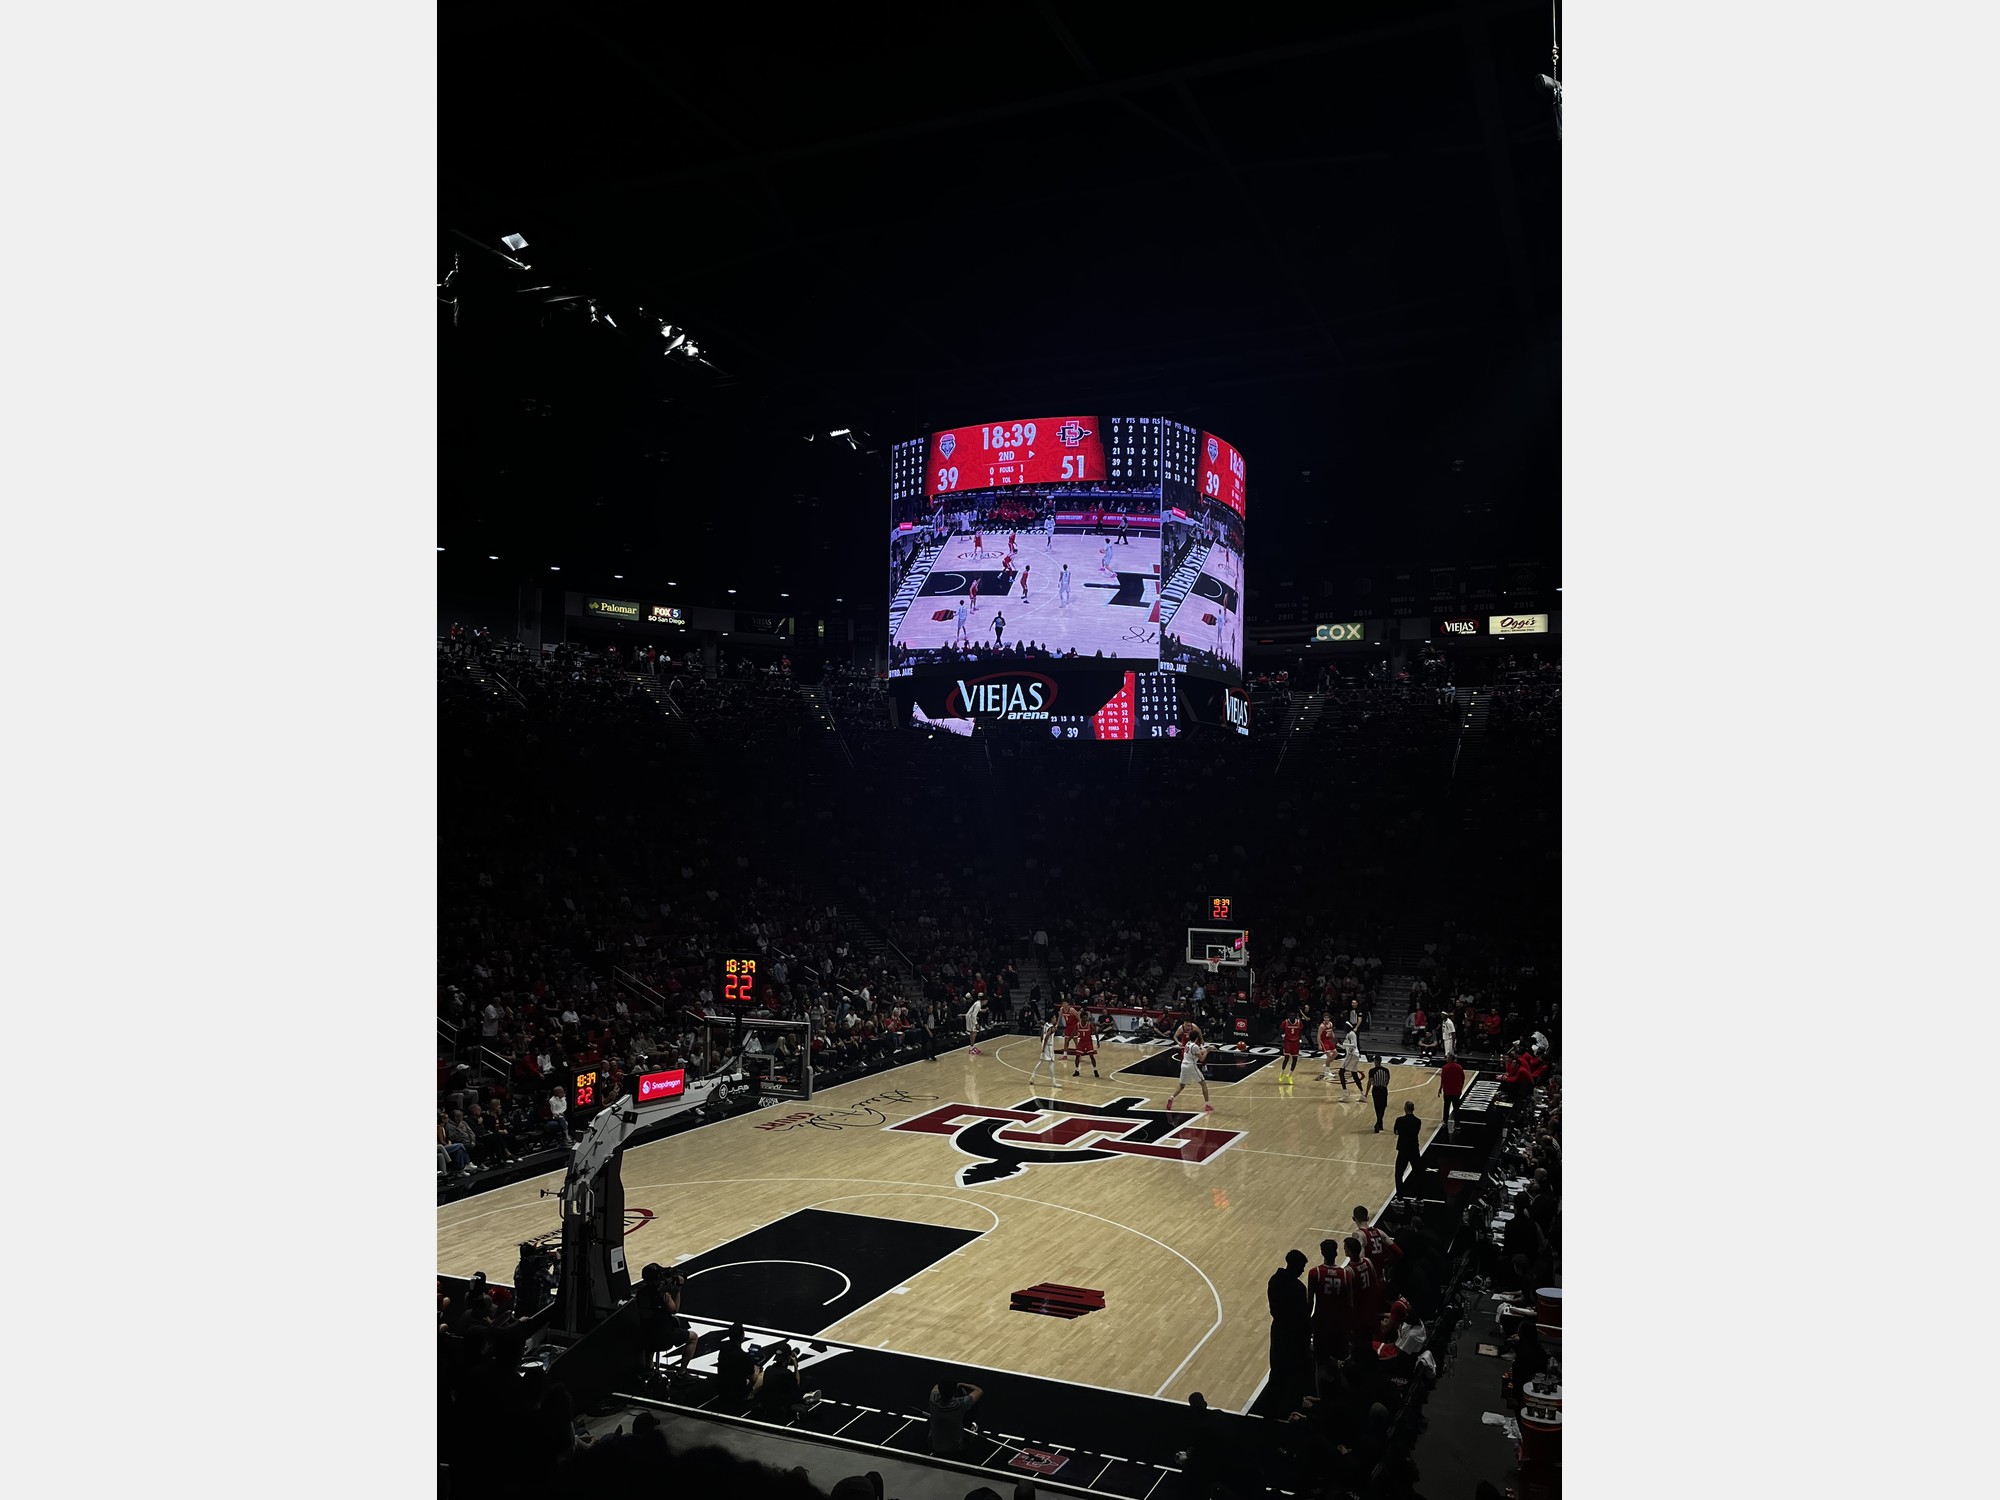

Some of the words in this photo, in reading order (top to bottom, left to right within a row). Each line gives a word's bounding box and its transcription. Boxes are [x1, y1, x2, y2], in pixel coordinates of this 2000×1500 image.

[982, 422, 1036, 450] 18:39
[998, 451, 1014, 462] 2ND
[990, 467, 994, 475] 0
[1060, 455, 1085, 479] 51
[938, 466, 958, 490] 39
[990, 478, 994, 486] 3
[1019, 475, 1024, 483] 3
[1206, 471, 1219, 496] 39
[601, 602, 637, 614] Palomar
[654, 607, 672, 617] FOX
[673, 609, 678, 618] 5
[1444, 622, 1474, 634] VIEJAS
[1500, 617, 1536, 629] Oggi's
[1316, 624, 1360, 640] COX
[957, 680, 1043, 719] VIEJAS
[1225, 688, 1248, 731] VIEJAS
[1067, 728, 1078, 738] 39
[1152, 726, 1162, 737] 51
[1213, 906, 1228, 917] 22
[726, 959, 756, 973] 18:39
[726, 974, 752, 1000] 22
[652, 1080, 680, 1090] Snapdragon
[577, 1087, 593, 1105] 22
[1371, 1237, 1383, 1254] 35
[1360, 1271, 1370, 1290] 31
